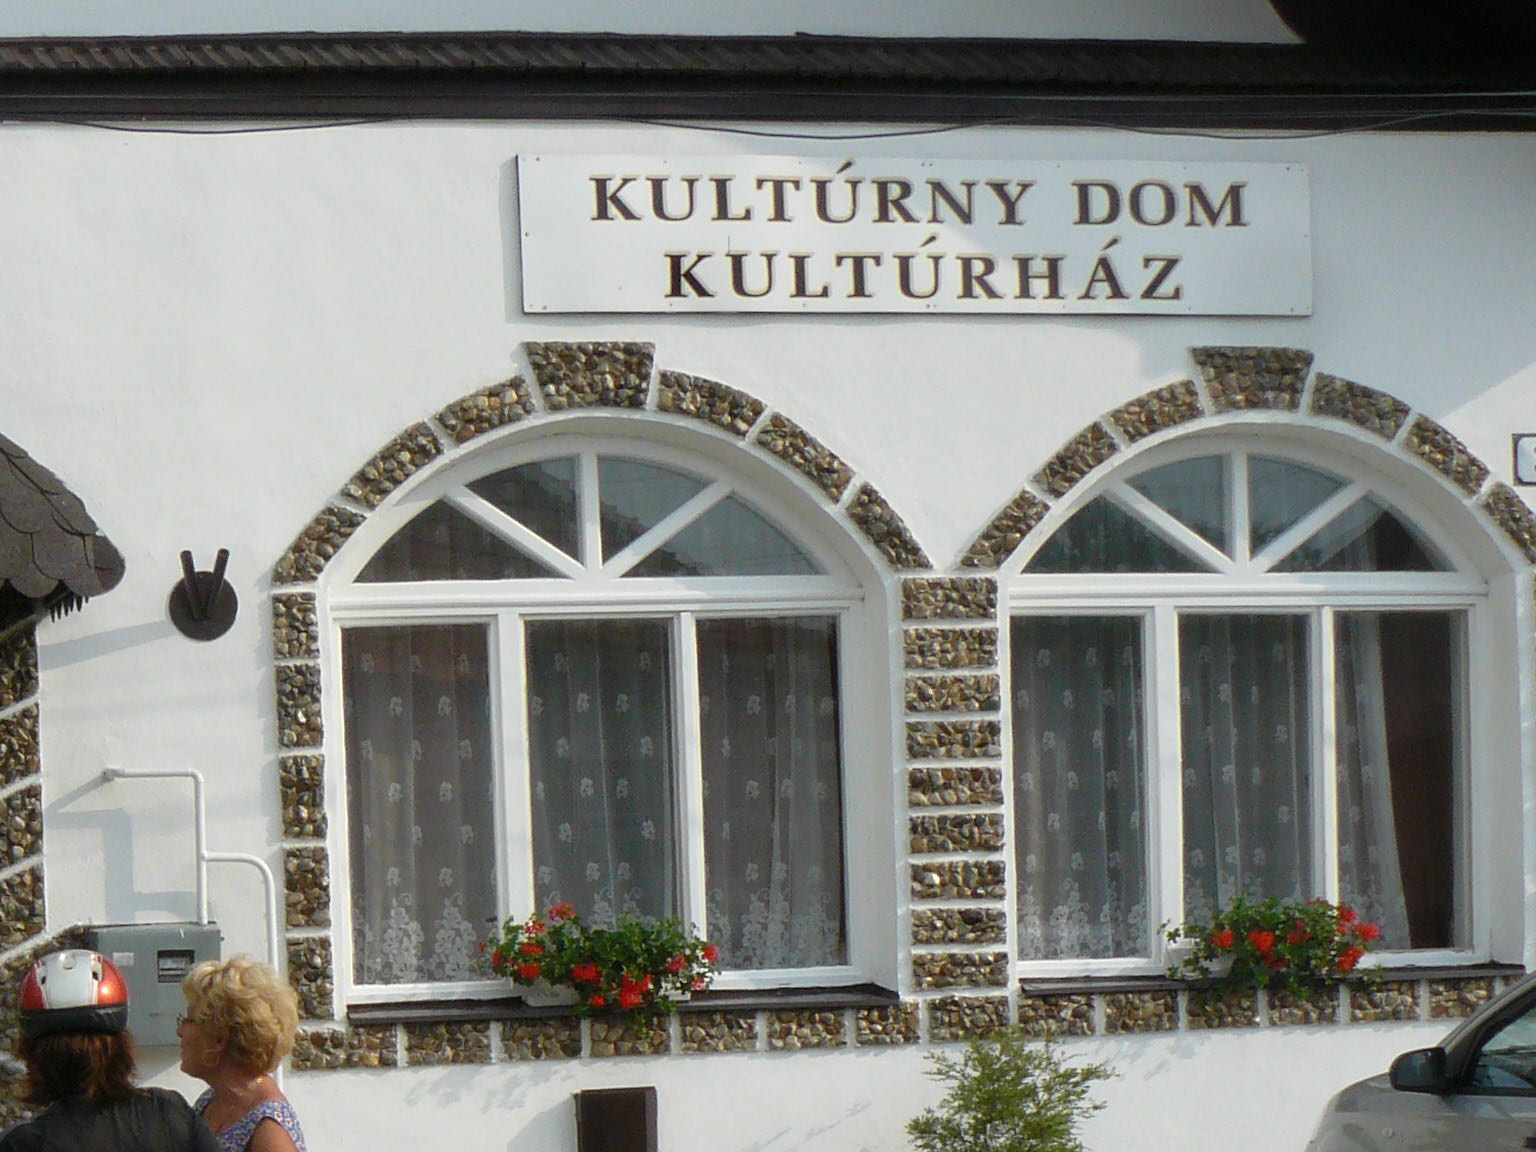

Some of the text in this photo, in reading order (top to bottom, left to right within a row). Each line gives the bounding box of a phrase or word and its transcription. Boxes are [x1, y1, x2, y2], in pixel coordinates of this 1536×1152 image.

[588, 158, 1250, 228] KULTÚRNY DOM
[663, 233, 1184, 301] KULTÚRHÁZ
